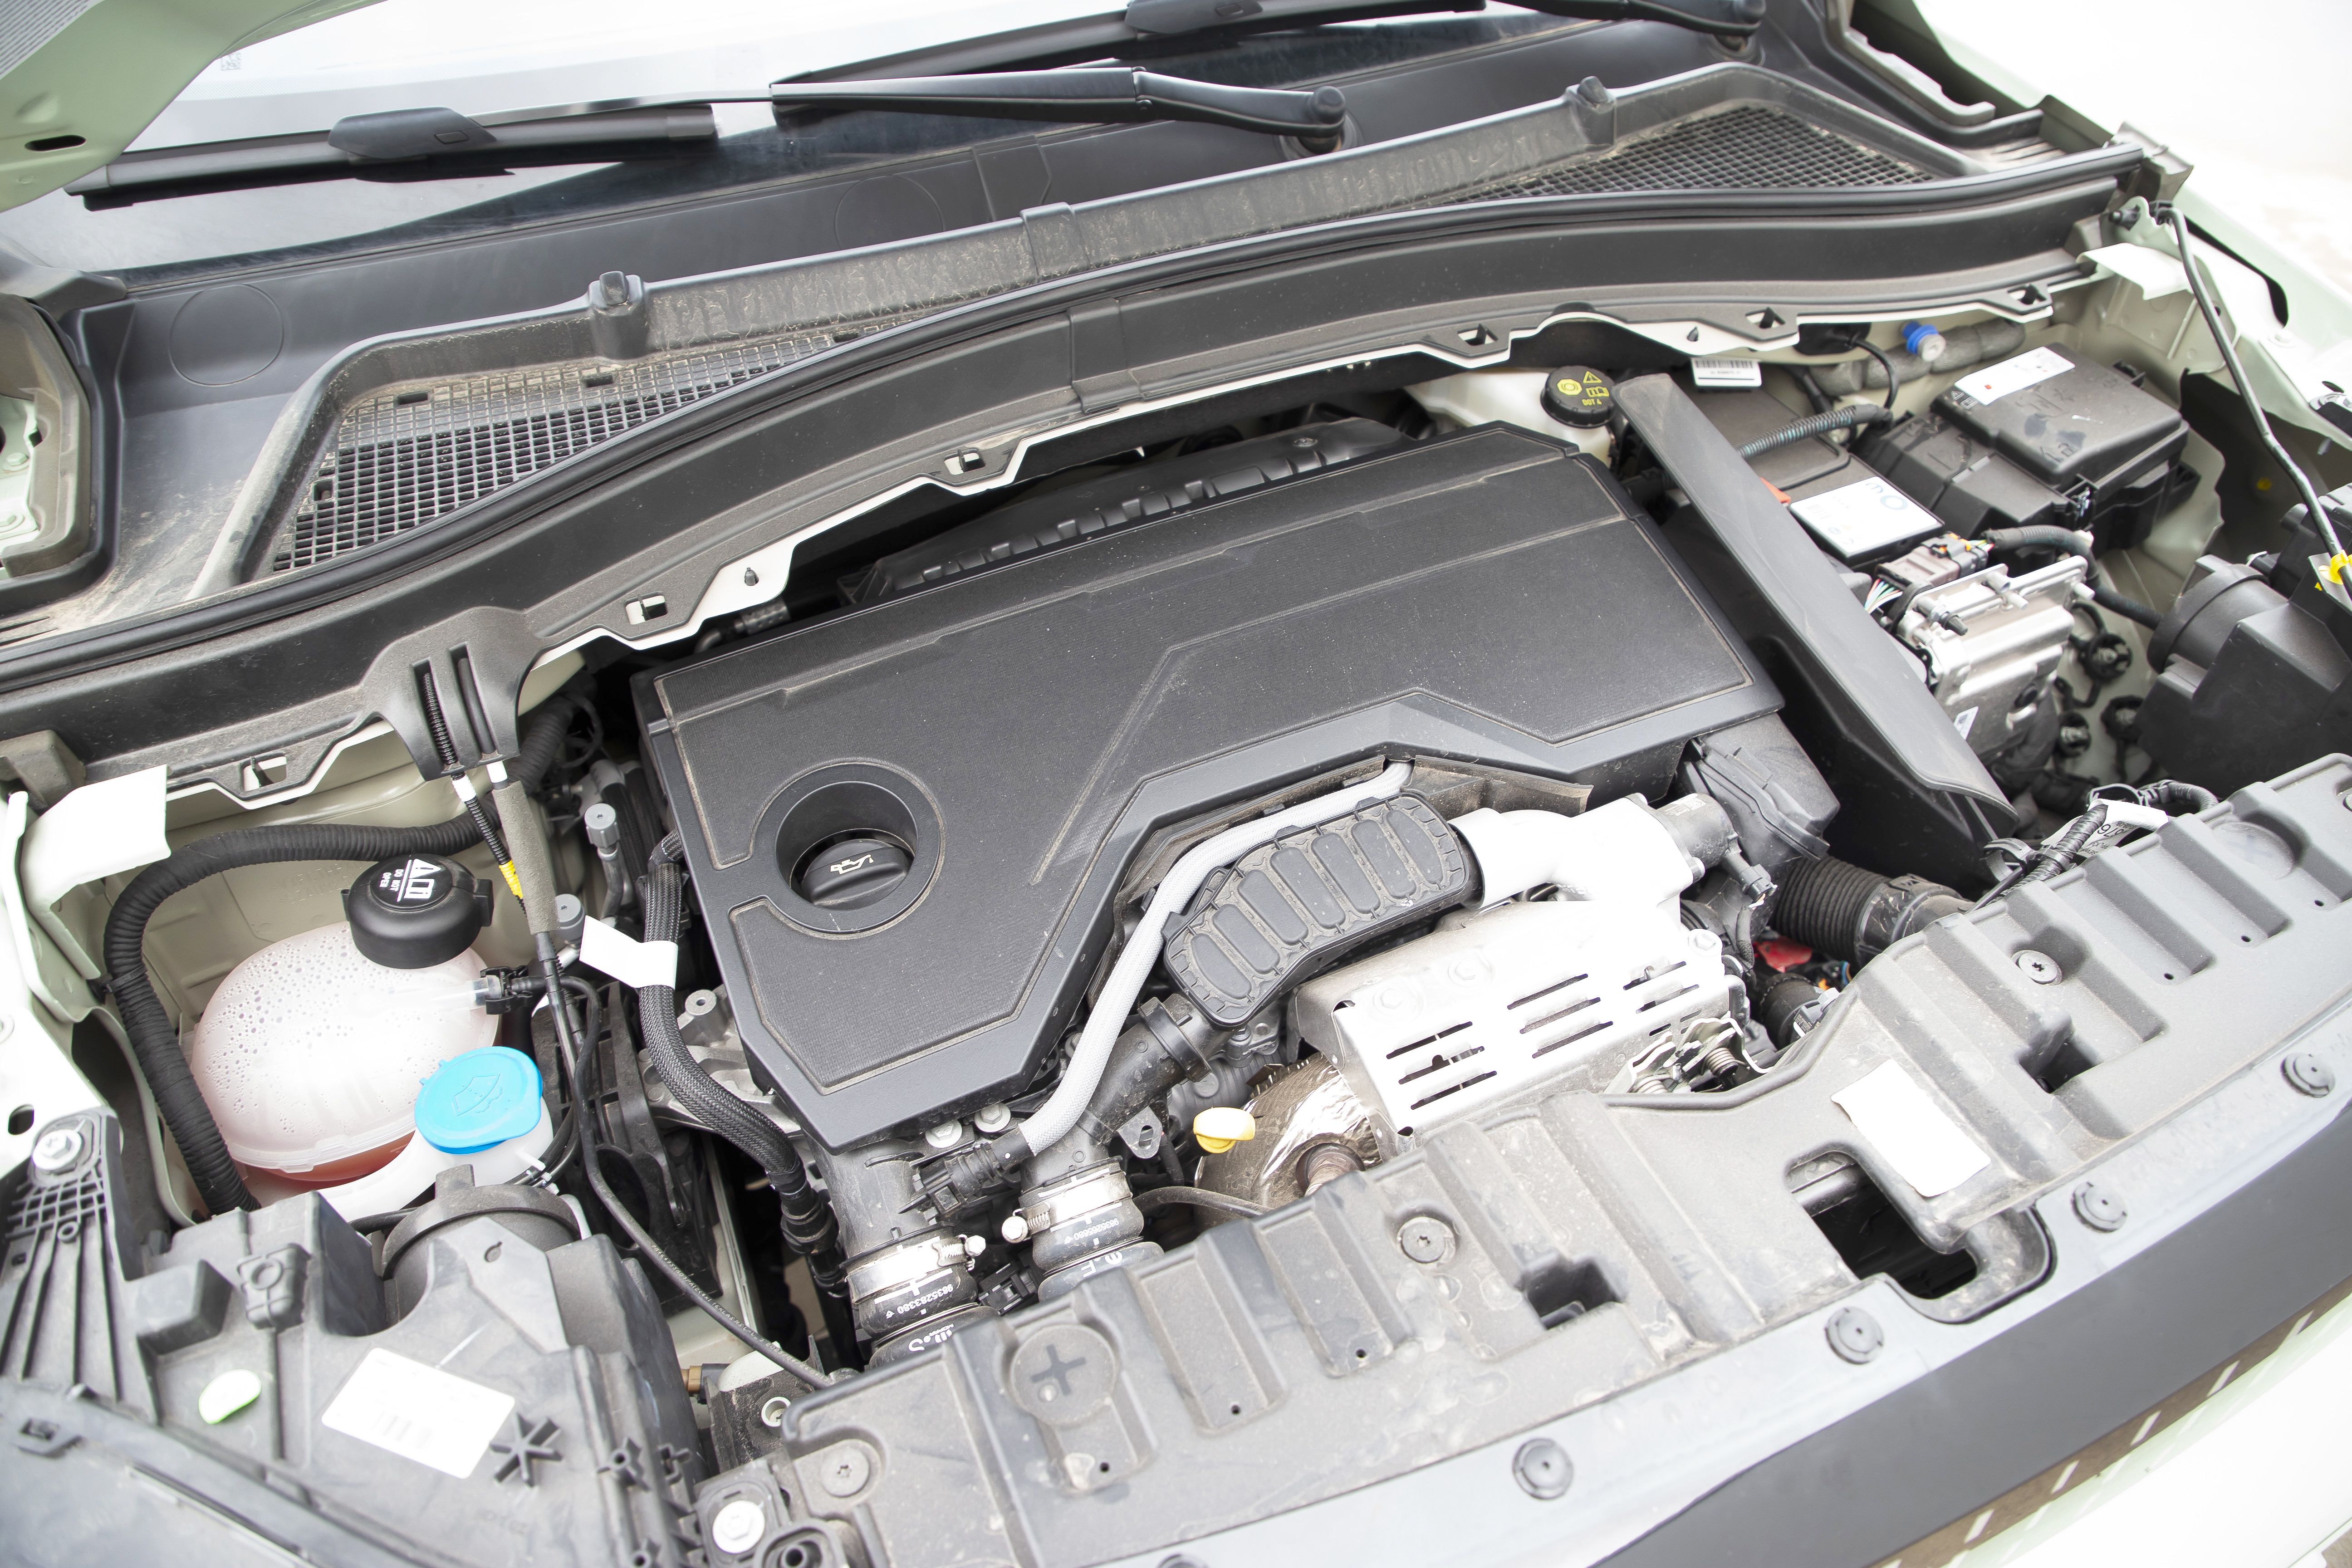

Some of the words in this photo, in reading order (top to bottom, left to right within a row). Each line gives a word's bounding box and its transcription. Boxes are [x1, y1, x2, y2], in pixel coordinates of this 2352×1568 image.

[1582, 398, 1596, 407] DOT
[379, 872, 392, 887] OPEN
[394, 869, 404, 877] DO
[389, 879, 401, 892] NOT
[897, 1284, 953, 1314] 9835283380
